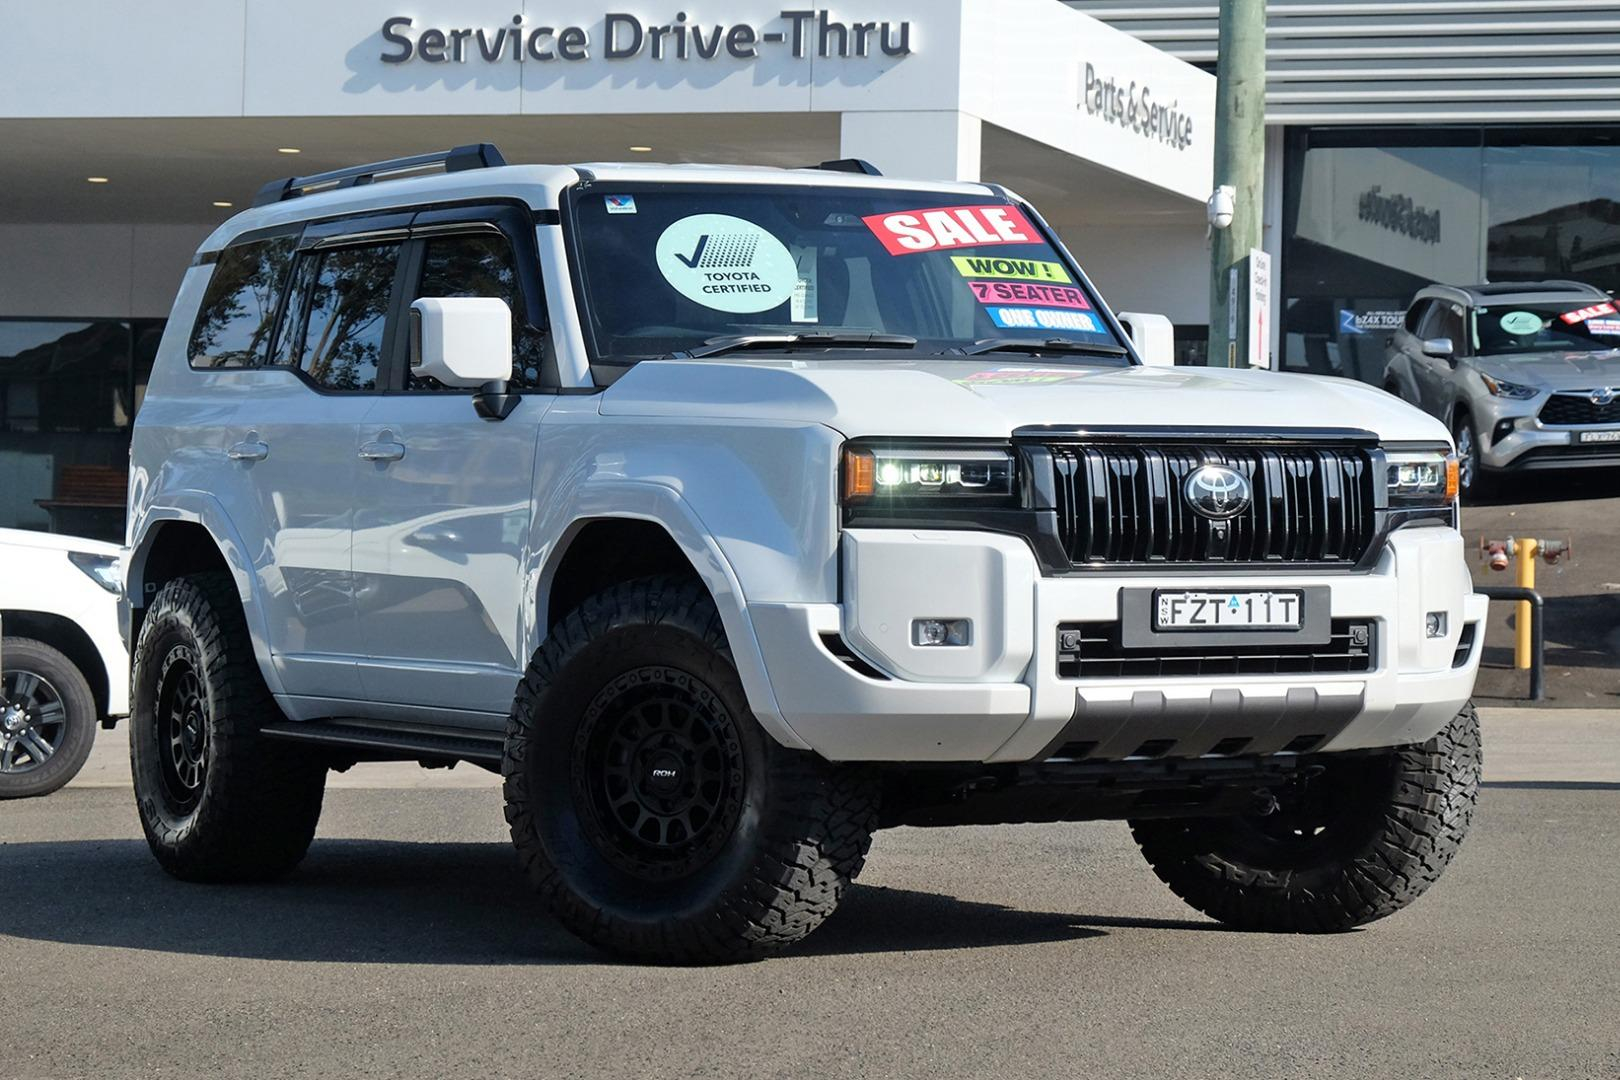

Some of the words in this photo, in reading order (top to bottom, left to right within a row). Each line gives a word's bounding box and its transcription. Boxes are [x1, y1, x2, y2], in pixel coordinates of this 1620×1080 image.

[380, 14, 588, 63] Service
[604, 9, 912, 60] Drive-Thru
[1085, 62, 1124, 118] Parts
[1128, 80, 1138, 122] &
[1141, 86, 1192, 146] Service
[883, 208, 1028, 250] SALE
[704, 271, 760, 282] TOYOTA
[966, 258, 1036, 277] WOW
[702, 283, 771, 294] CERTIFIED
[972, 283, 990, 299] 7
[996, 284, 1083, 305] SEATER
[1565, 303, 1613, 323] SALE
[653, 769, 676, 777] ROH
